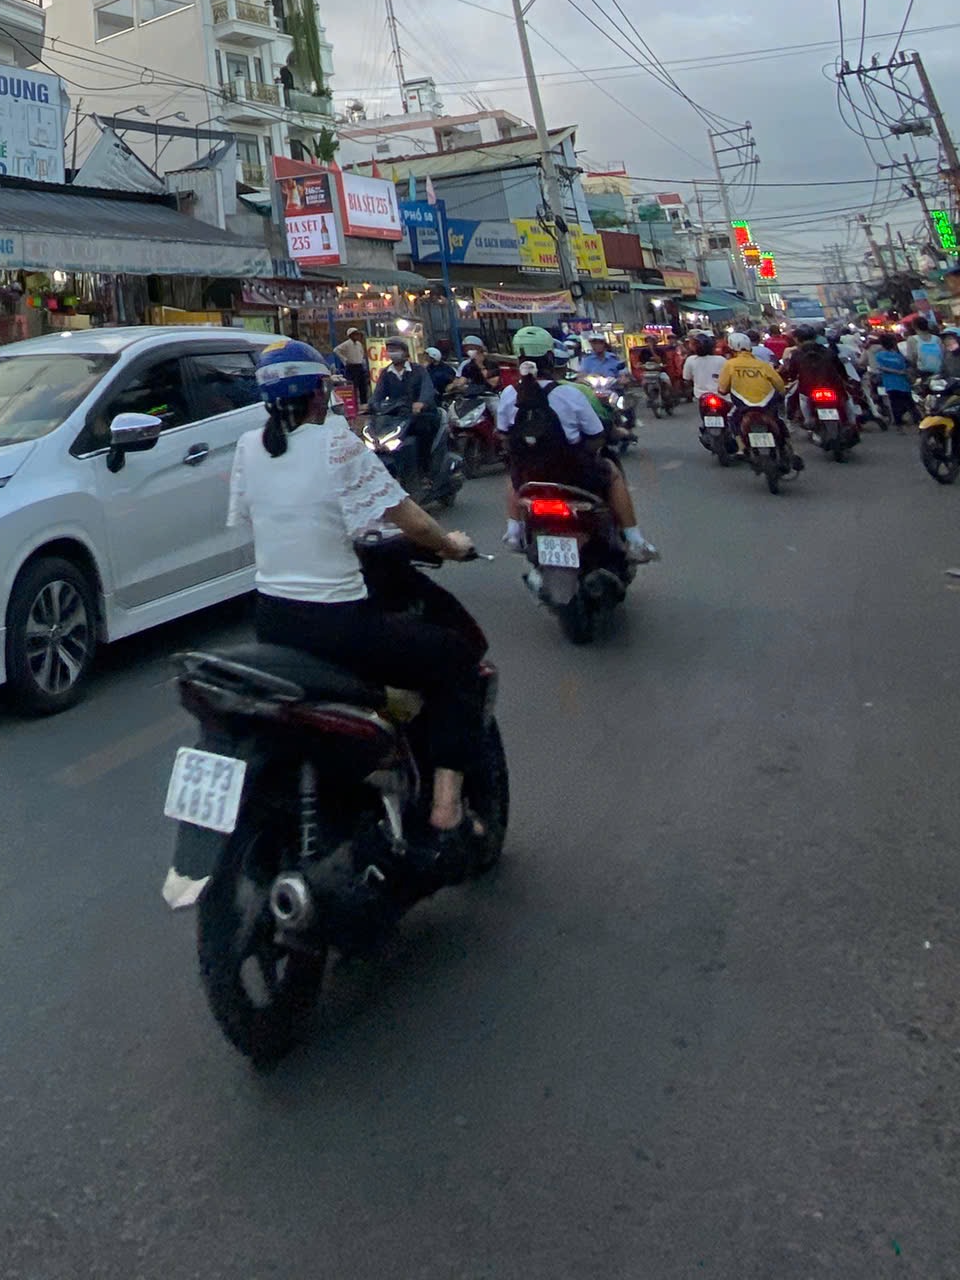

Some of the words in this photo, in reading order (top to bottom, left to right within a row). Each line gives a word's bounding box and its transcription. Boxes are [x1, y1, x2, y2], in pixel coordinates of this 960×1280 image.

[347, 192, 362, 211] BIA
[376, 198, 388, 215] 235
[292, 235, 310, 250] 235
